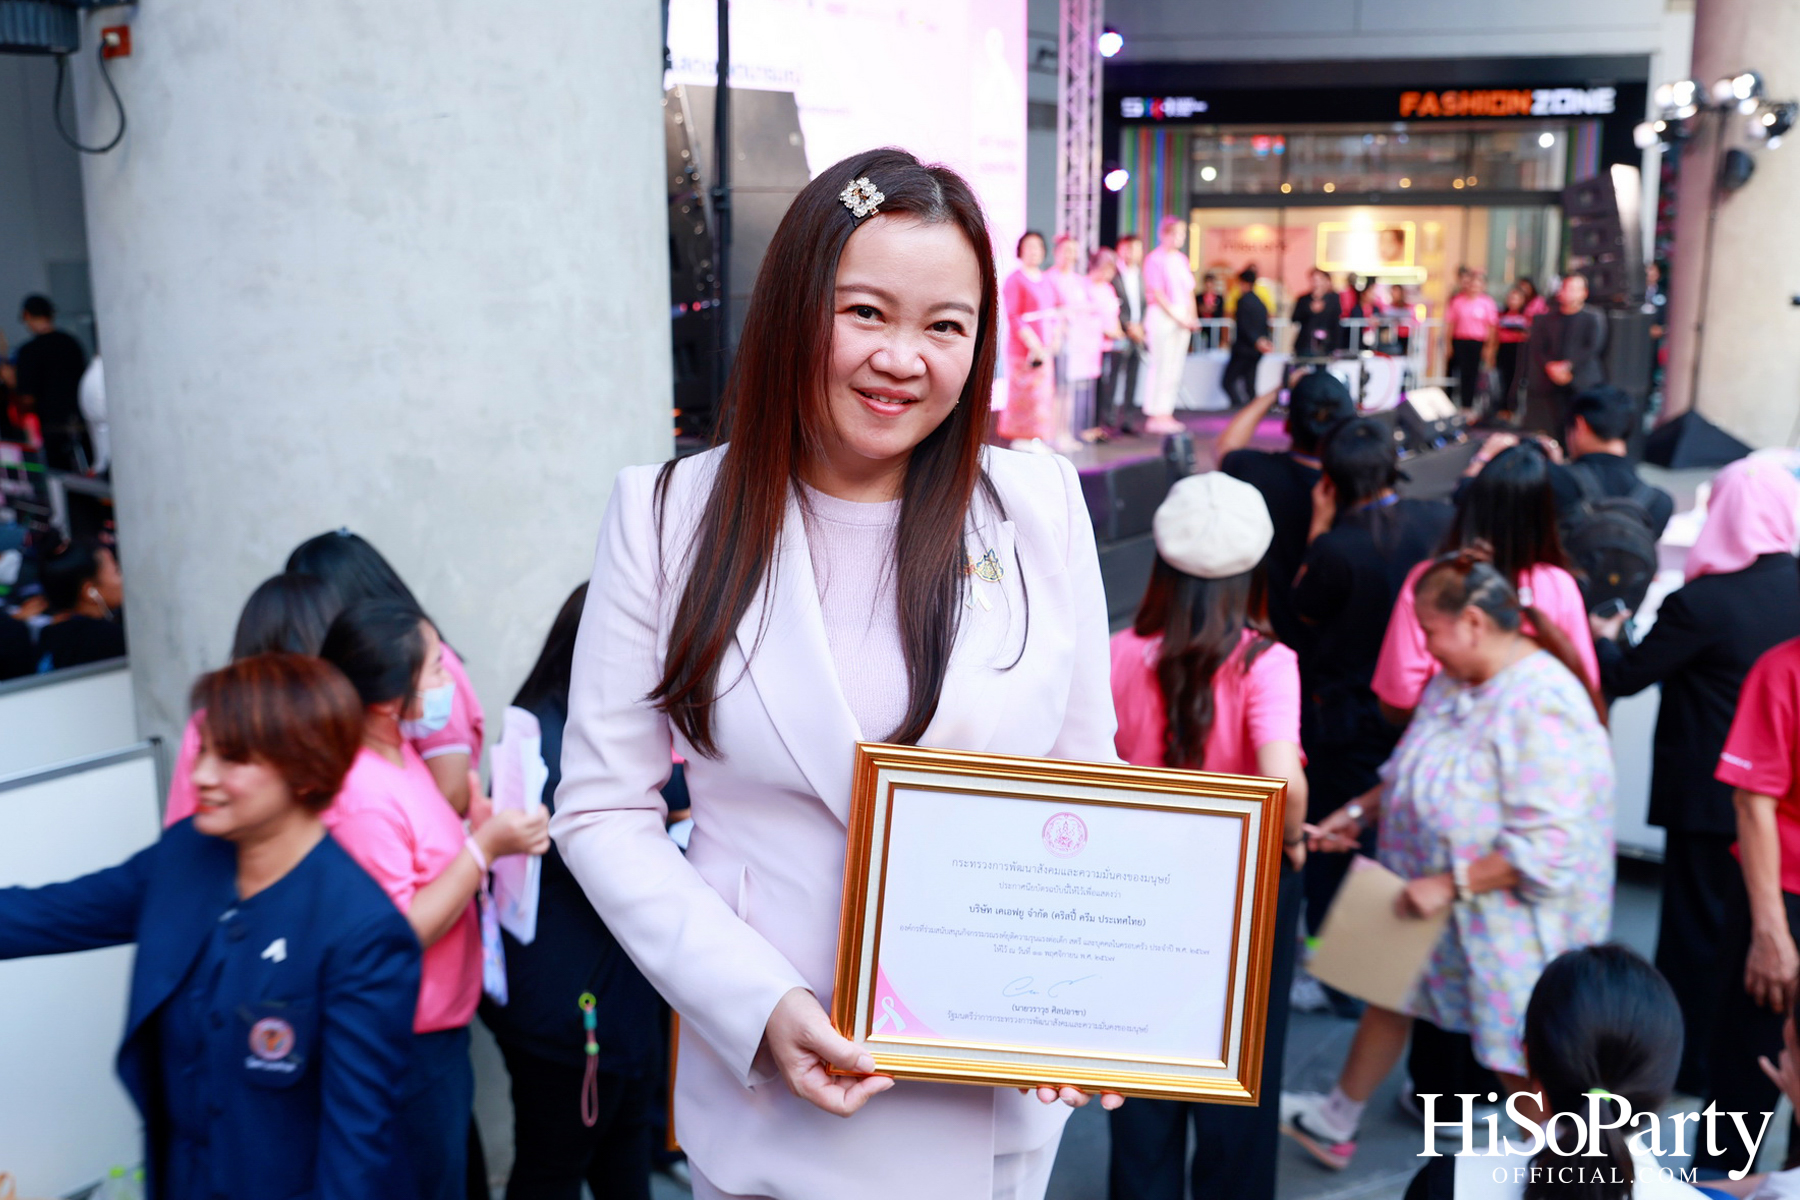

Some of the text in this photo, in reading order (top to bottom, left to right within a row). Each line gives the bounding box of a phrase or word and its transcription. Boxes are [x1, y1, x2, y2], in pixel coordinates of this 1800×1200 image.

[952, 857, 1171, 886] กระทรวงการพัฒนาสังคมและความมั่นคงของมนุษย์
[969, 904, 1147, 927] บริษัท เคเอฟยู จำกัด (คริสปี้ ครีม ประเทศไทย)
[1011, 1003, 1087, 1017] (นายวราวุธ ศิลปอาชา)
